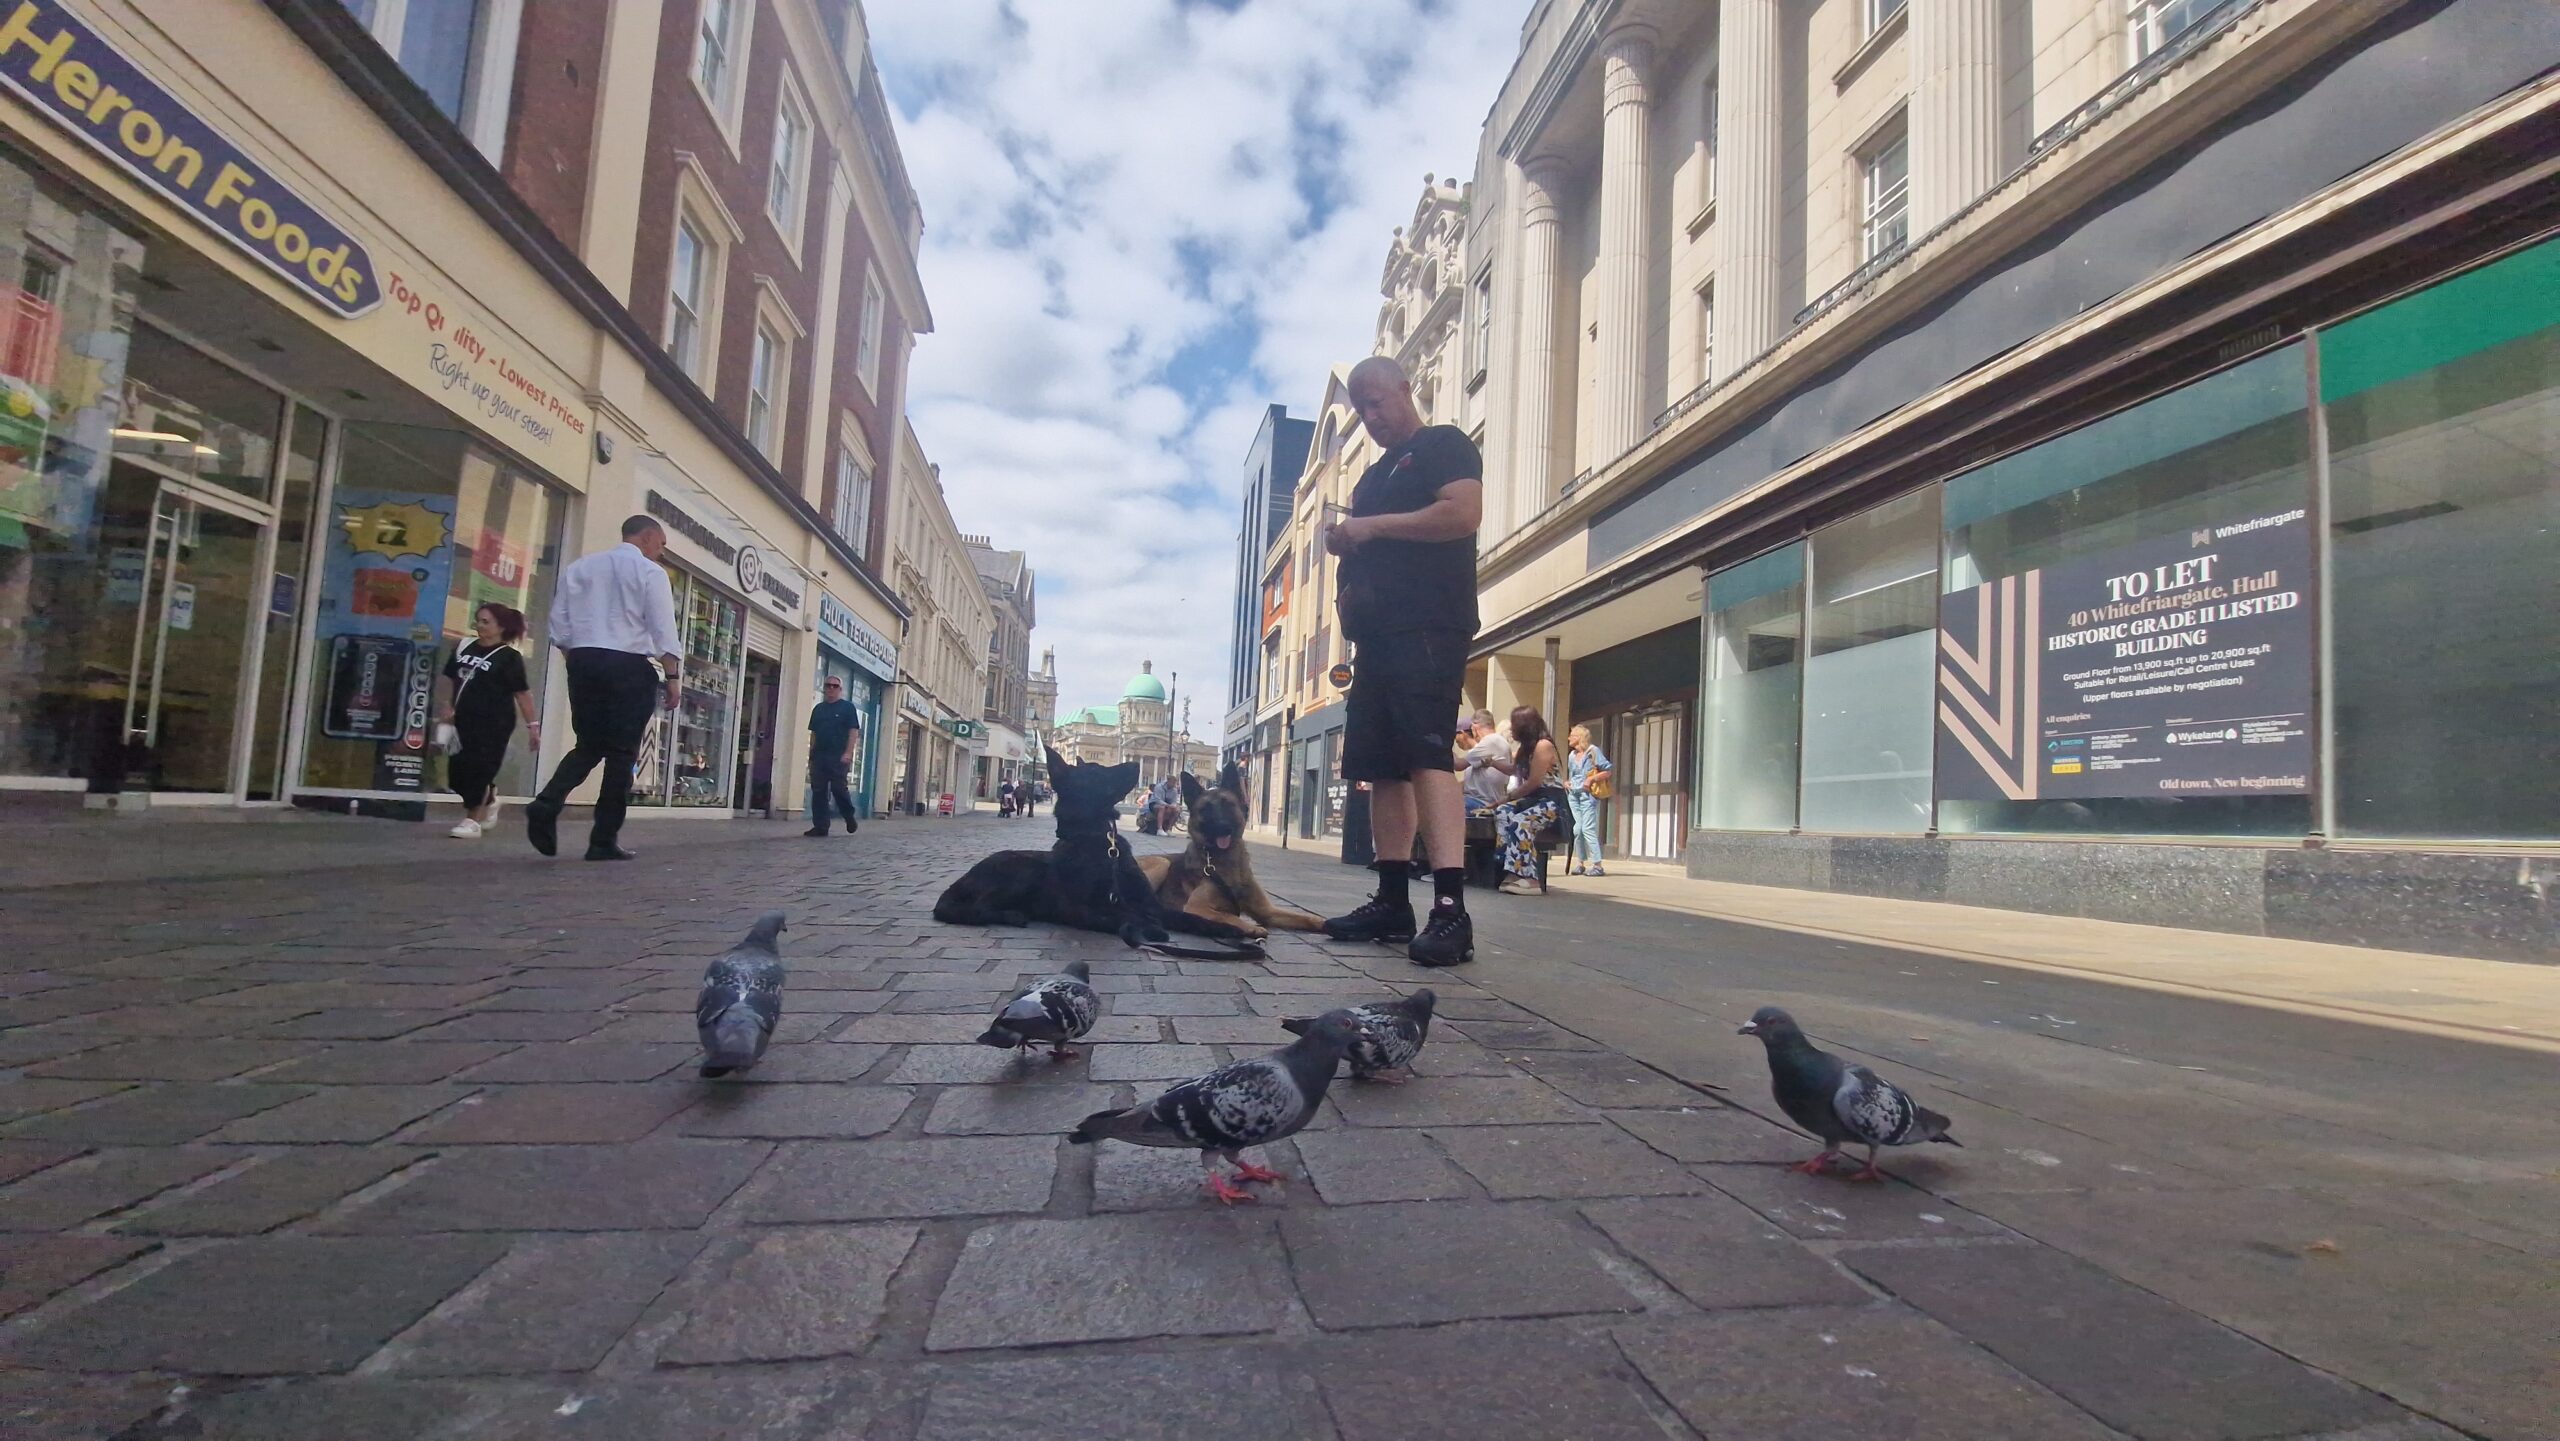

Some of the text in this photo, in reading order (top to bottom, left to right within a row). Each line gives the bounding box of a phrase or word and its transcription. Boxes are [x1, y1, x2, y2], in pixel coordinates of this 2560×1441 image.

[0, 2, 363, 304] Heron Foods
[389, 271, 422, 315] Top
[500, 358, 546, 407] Lowest
[549, 396, 585, 435] Prices
[430, 343, 554, 445] Right up your street!
[2216, 508, 2305, 539] Whitefriargate
[2106, 554, 2218, 602] TO LET
[822, 597, 847, 635] HULL
[2067, 610, 2088, 628] 40
[2231, 570, 2278, 595] Hull
[2048, 591, 2299, 651] HISTORIC GRADE II LISTED
[2063, 669, 2090, 681] Ground
[2092, 668, 2112, 677] Floor
[2113, 665, 2132, 674] from
[2133, 659, 2162, 671] 13,900
[2185, 655, 2197, 665] up
[2199, 653, 2209, 661] to
[2211, 647, 2245, 660] 20,900
[2247, 643, 2272, 655] sq.ft
[2115, 629, 2208, 658] BUILDING
[2073, 658, 2255, 690] Suitable for Retail/Leisure/Call Centre Uses
[2082, 675, 2243, 703] (Upper floors available by negotiation)
[2046, 712, 2091, 723] All enquiries
[2177, 730, 2224, 742] Wykeland
[2159, 778, 2179, 789] Old
[2213, 777, 2239, 788] New
[2240, 775, 2306, 789] beginning
